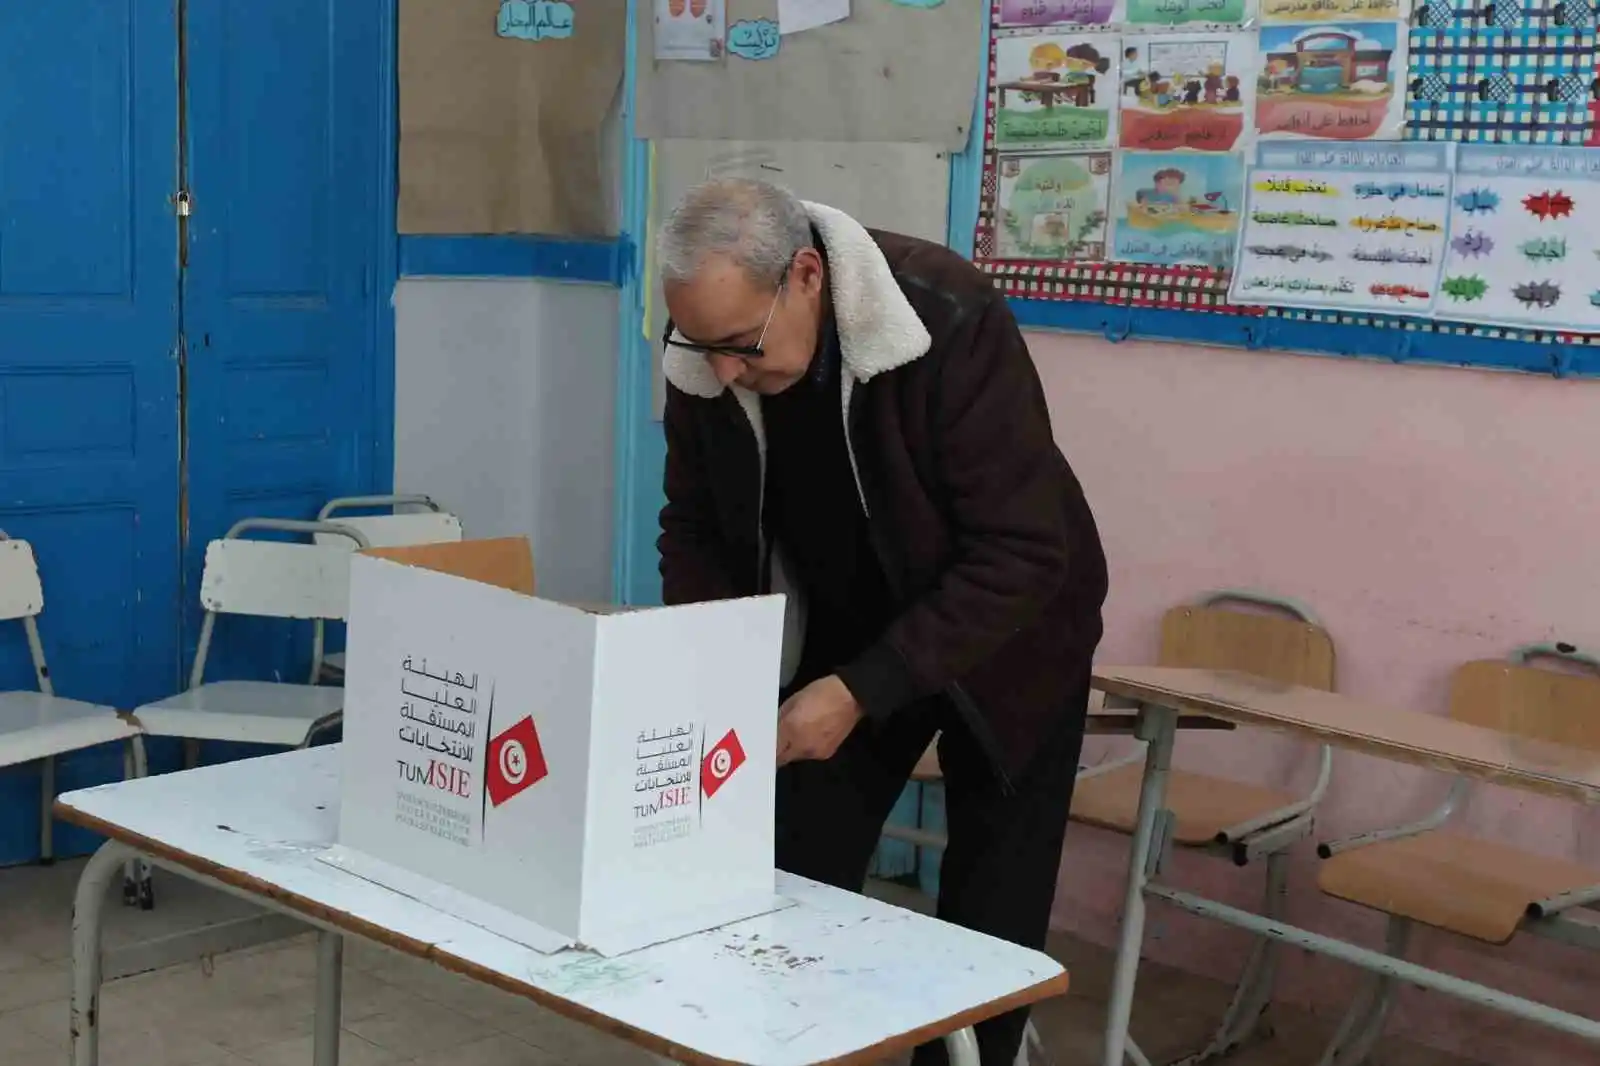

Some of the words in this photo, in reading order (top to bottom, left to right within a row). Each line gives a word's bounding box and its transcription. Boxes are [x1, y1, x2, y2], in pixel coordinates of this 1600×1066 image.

[402, 654, 479, 692] الهيئة
[401, 677, 477, 715] العليا
[400, 702, 476, 739] المستقلة
[399, 726, 473, 763] للانتخابات
[636, 738, 693, 760] العليا
[634, 771, 692, 792] للانتخابات
[636, 755, 692, 777] المستقلة
